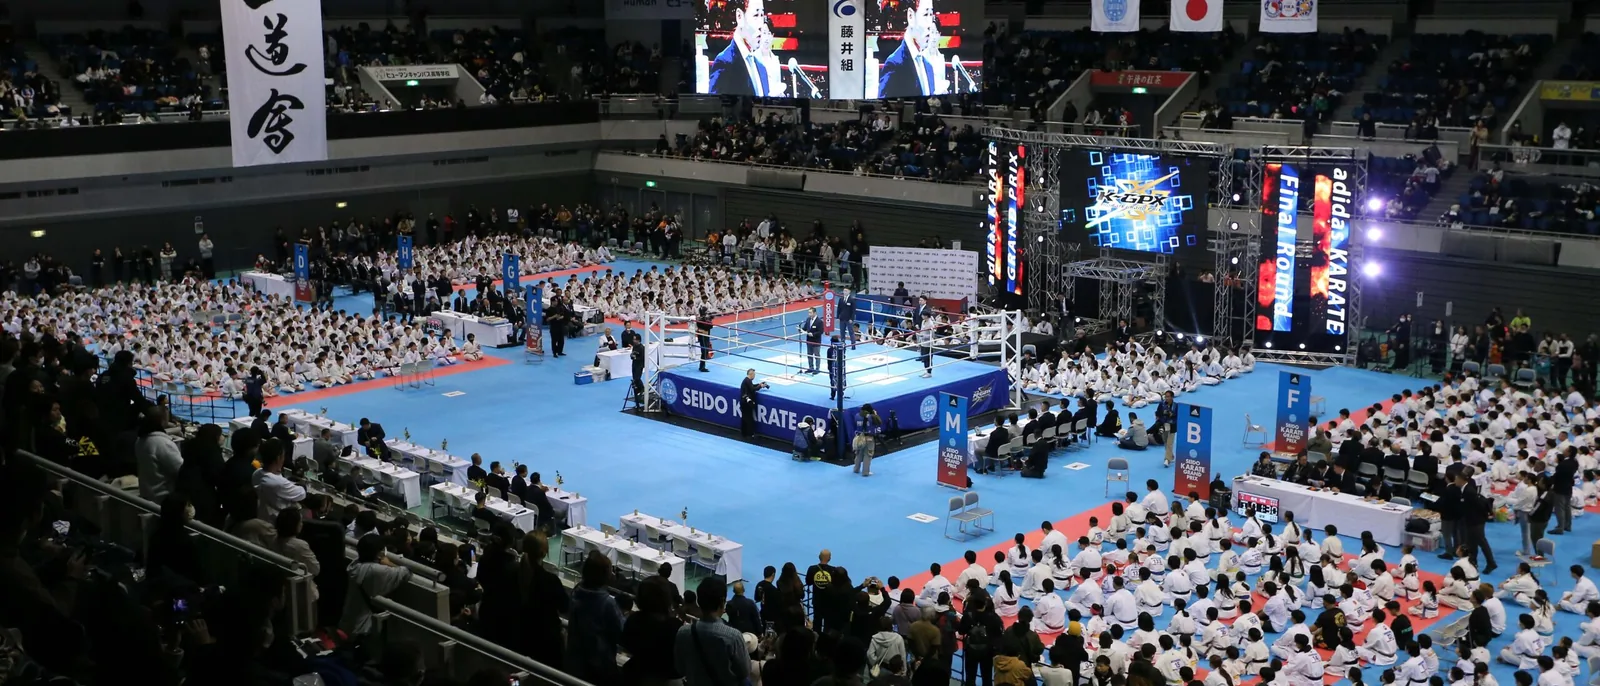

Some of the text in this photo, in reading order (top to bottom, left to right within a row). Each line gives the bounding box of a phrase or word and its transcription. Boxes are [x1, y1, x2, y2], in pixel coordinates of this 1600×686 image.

[841, 25, 854, 72] 藤井組
[1126, 74, 1162, 85] 午後の紅茶
[1097, 192, 1168, 206] K-GPX
[986, 140, 998, 287] adidas KARATE
[1007, 151, 1019, 281] GRAND PRIX
[401, 246, 409, 260] H
[1273, 173, 1299, 319] Final Round
[1326, 167, 1352, 335] adidas KARATE
[298, 255, 304, 268] D
[507, 265, 515, 279] G
[531, 299, 538, 314] C
[1287, 389, 1300, 408] F
[682, 387, 728, 415] SEIDO
[732, 398, 798, 431] KRATE
[946, 412, 960, 433] M
[1187, 422, 1201, 443] B
[1280, 426, 1304, 437] KARATE
[942, 451, 963, 461] KARATE
[1185, 458, 1201, 466] SEIDO
[1180, 463, 1206, 474] KARATE
[1182, 470, 1202, 478] GRAND
